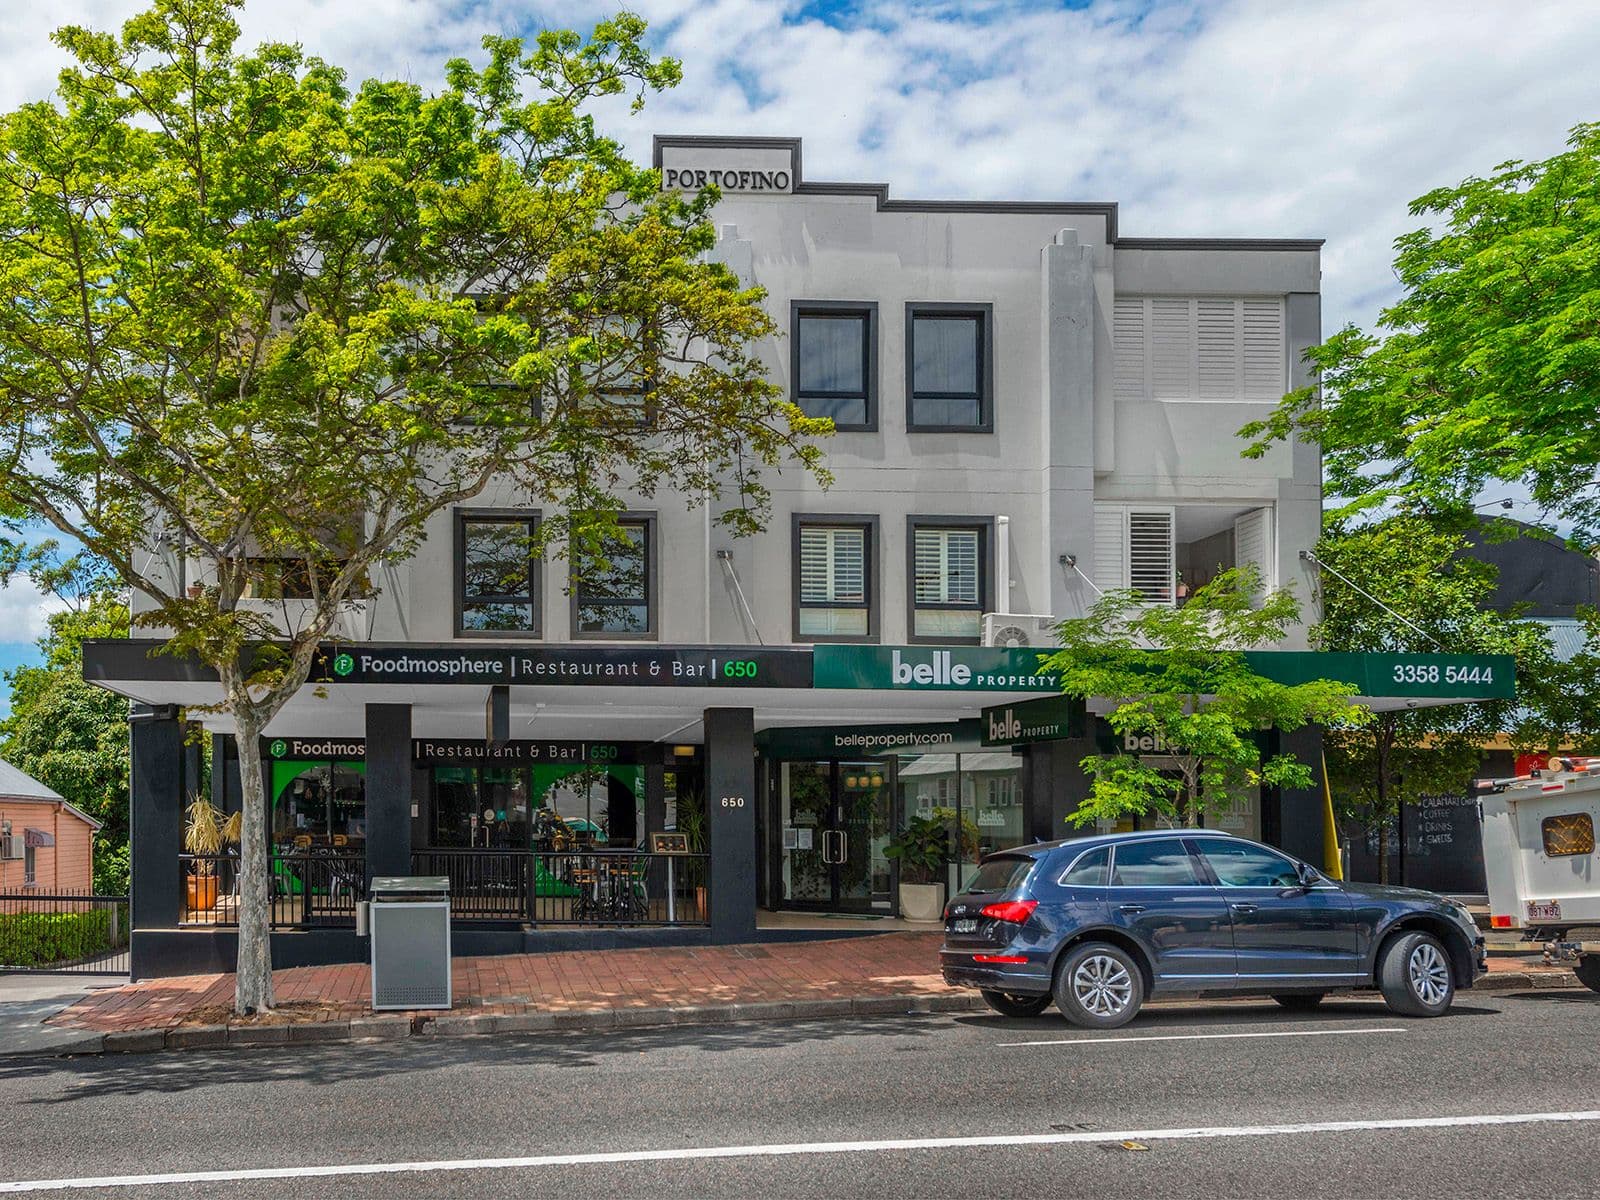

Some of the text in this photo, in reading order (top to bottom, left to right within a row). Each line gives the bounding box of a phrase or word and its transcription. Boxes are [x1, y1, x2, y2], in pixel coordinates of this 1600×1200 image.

[666, 169, 789, 190] PORTOFINO
[361, 655, 758, 678] Foodmosphere Restaurant & Bar 650
[892, 650, 1056, 686] belle PROPERTY
[1393, 665, 1493, 684] 3358 5444
[989, 709, 1059, 741] belle PROPERTY
[834, 731, 952, 749] belleproperty.com
[293, 741, 618, 760] Foodmos Restaurant & Bar 650
[721, 797, 744, 807] 650
